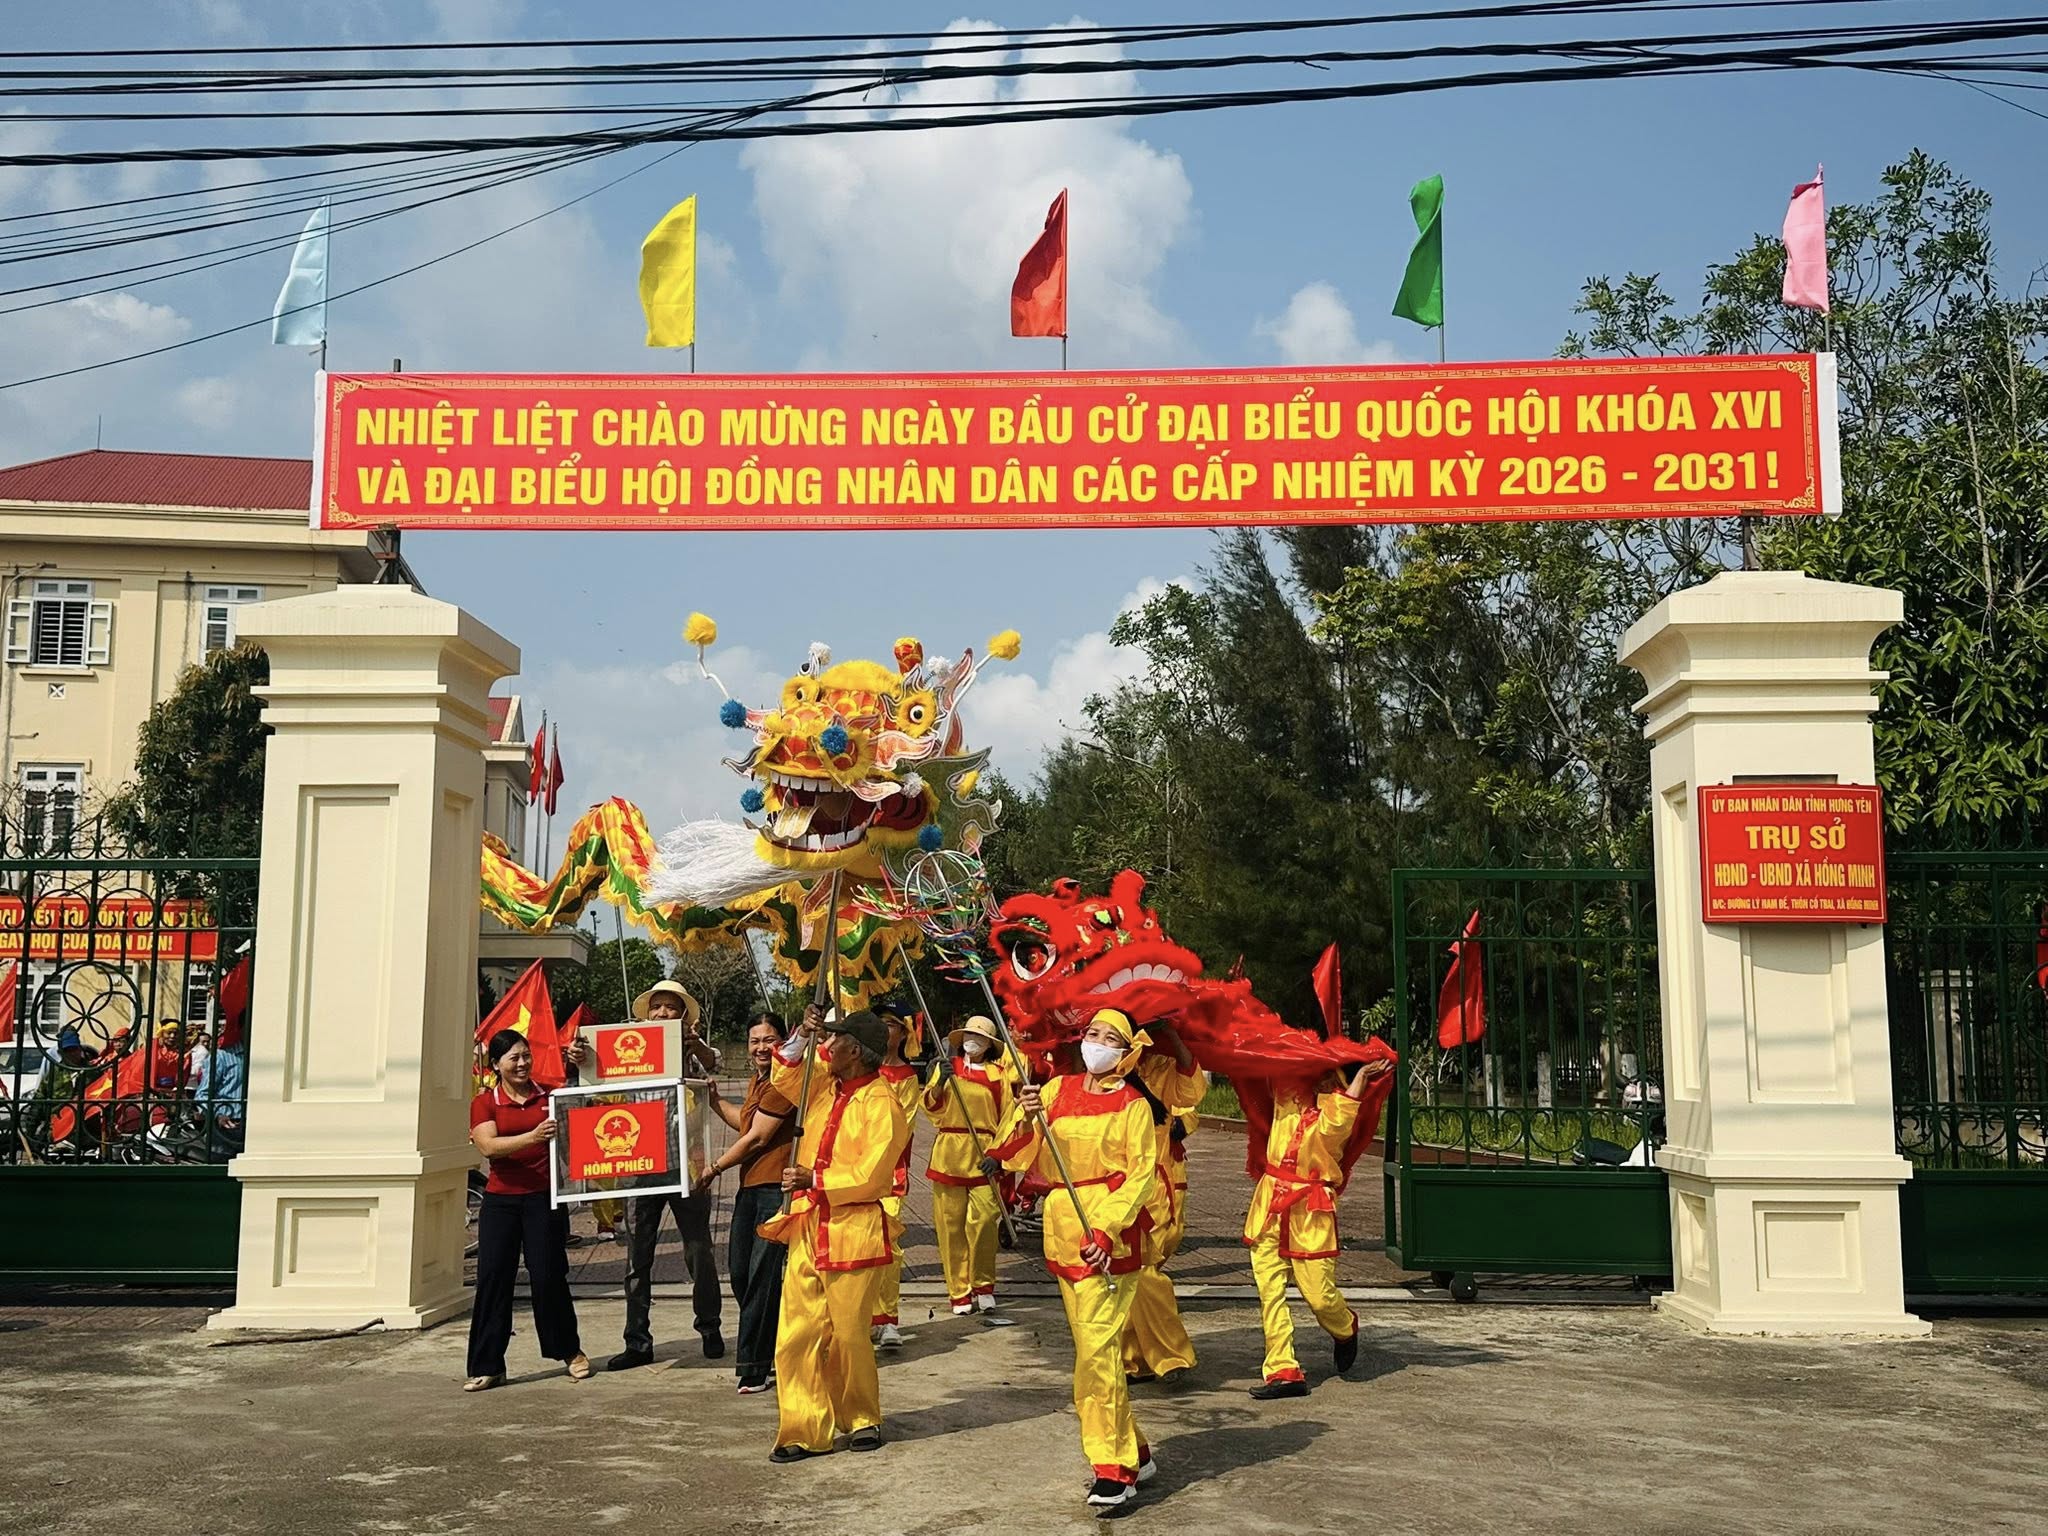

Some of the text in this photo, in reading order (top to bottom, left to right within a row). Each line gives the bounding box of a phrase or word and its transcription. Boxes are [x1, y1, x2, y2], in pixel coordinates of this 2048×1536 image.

[357, 384, 1781, 453] NHIỆT LIỆT CHÀO MỪNG NGÀY BẦU CỬ ĐẠI BIỂU QUỐC HỘI KHÓA XVI
[358, 458, 410, 504] VÀ
[425, 467, 495, 513] ĐẠI
[511, 451, 607, 505] BIỂU
[622, 460, 691, 513] HỘI
[706, 453, 822, 505] ĐỒNG
[837, 459, 955, 504] NHÂN
[971, 458, 1057, 503] DÂN
[1073, 454, 1157, 502] CÁC
[1173, 444, 1257, 501] CẤP
[1273, 453, 1413, 507] NHIỆM
[1430, 450, 1484, 497] KỲ
[1500, 457, 1606, 495] 2026
[1624, 472, 1637, 480] -
[1728, 798, 1749, 813] BAN
[1751, 795, 1780, 812] NHÂN
[1782, 795, 1803, 812] DÂN
[1805, 793, 1827, 812] TỈNH
[1829, 797, 1854, 813] HƯNG
[1855, 797, 1872, 814] YÊN
[1745, 817, 1846, 854] TRỤ SỞ
[1714, 863, 1748, 887] HĐND
[1759, 863, 1793, 887] UBND
[1795, 860, 1812, 887] XÃ
[1814, 857, 1846, 887] HỒNG
[1848, 863, 1876, 888] MINH
[584, 1156, 654, 1176] HÒM PHIẾU
